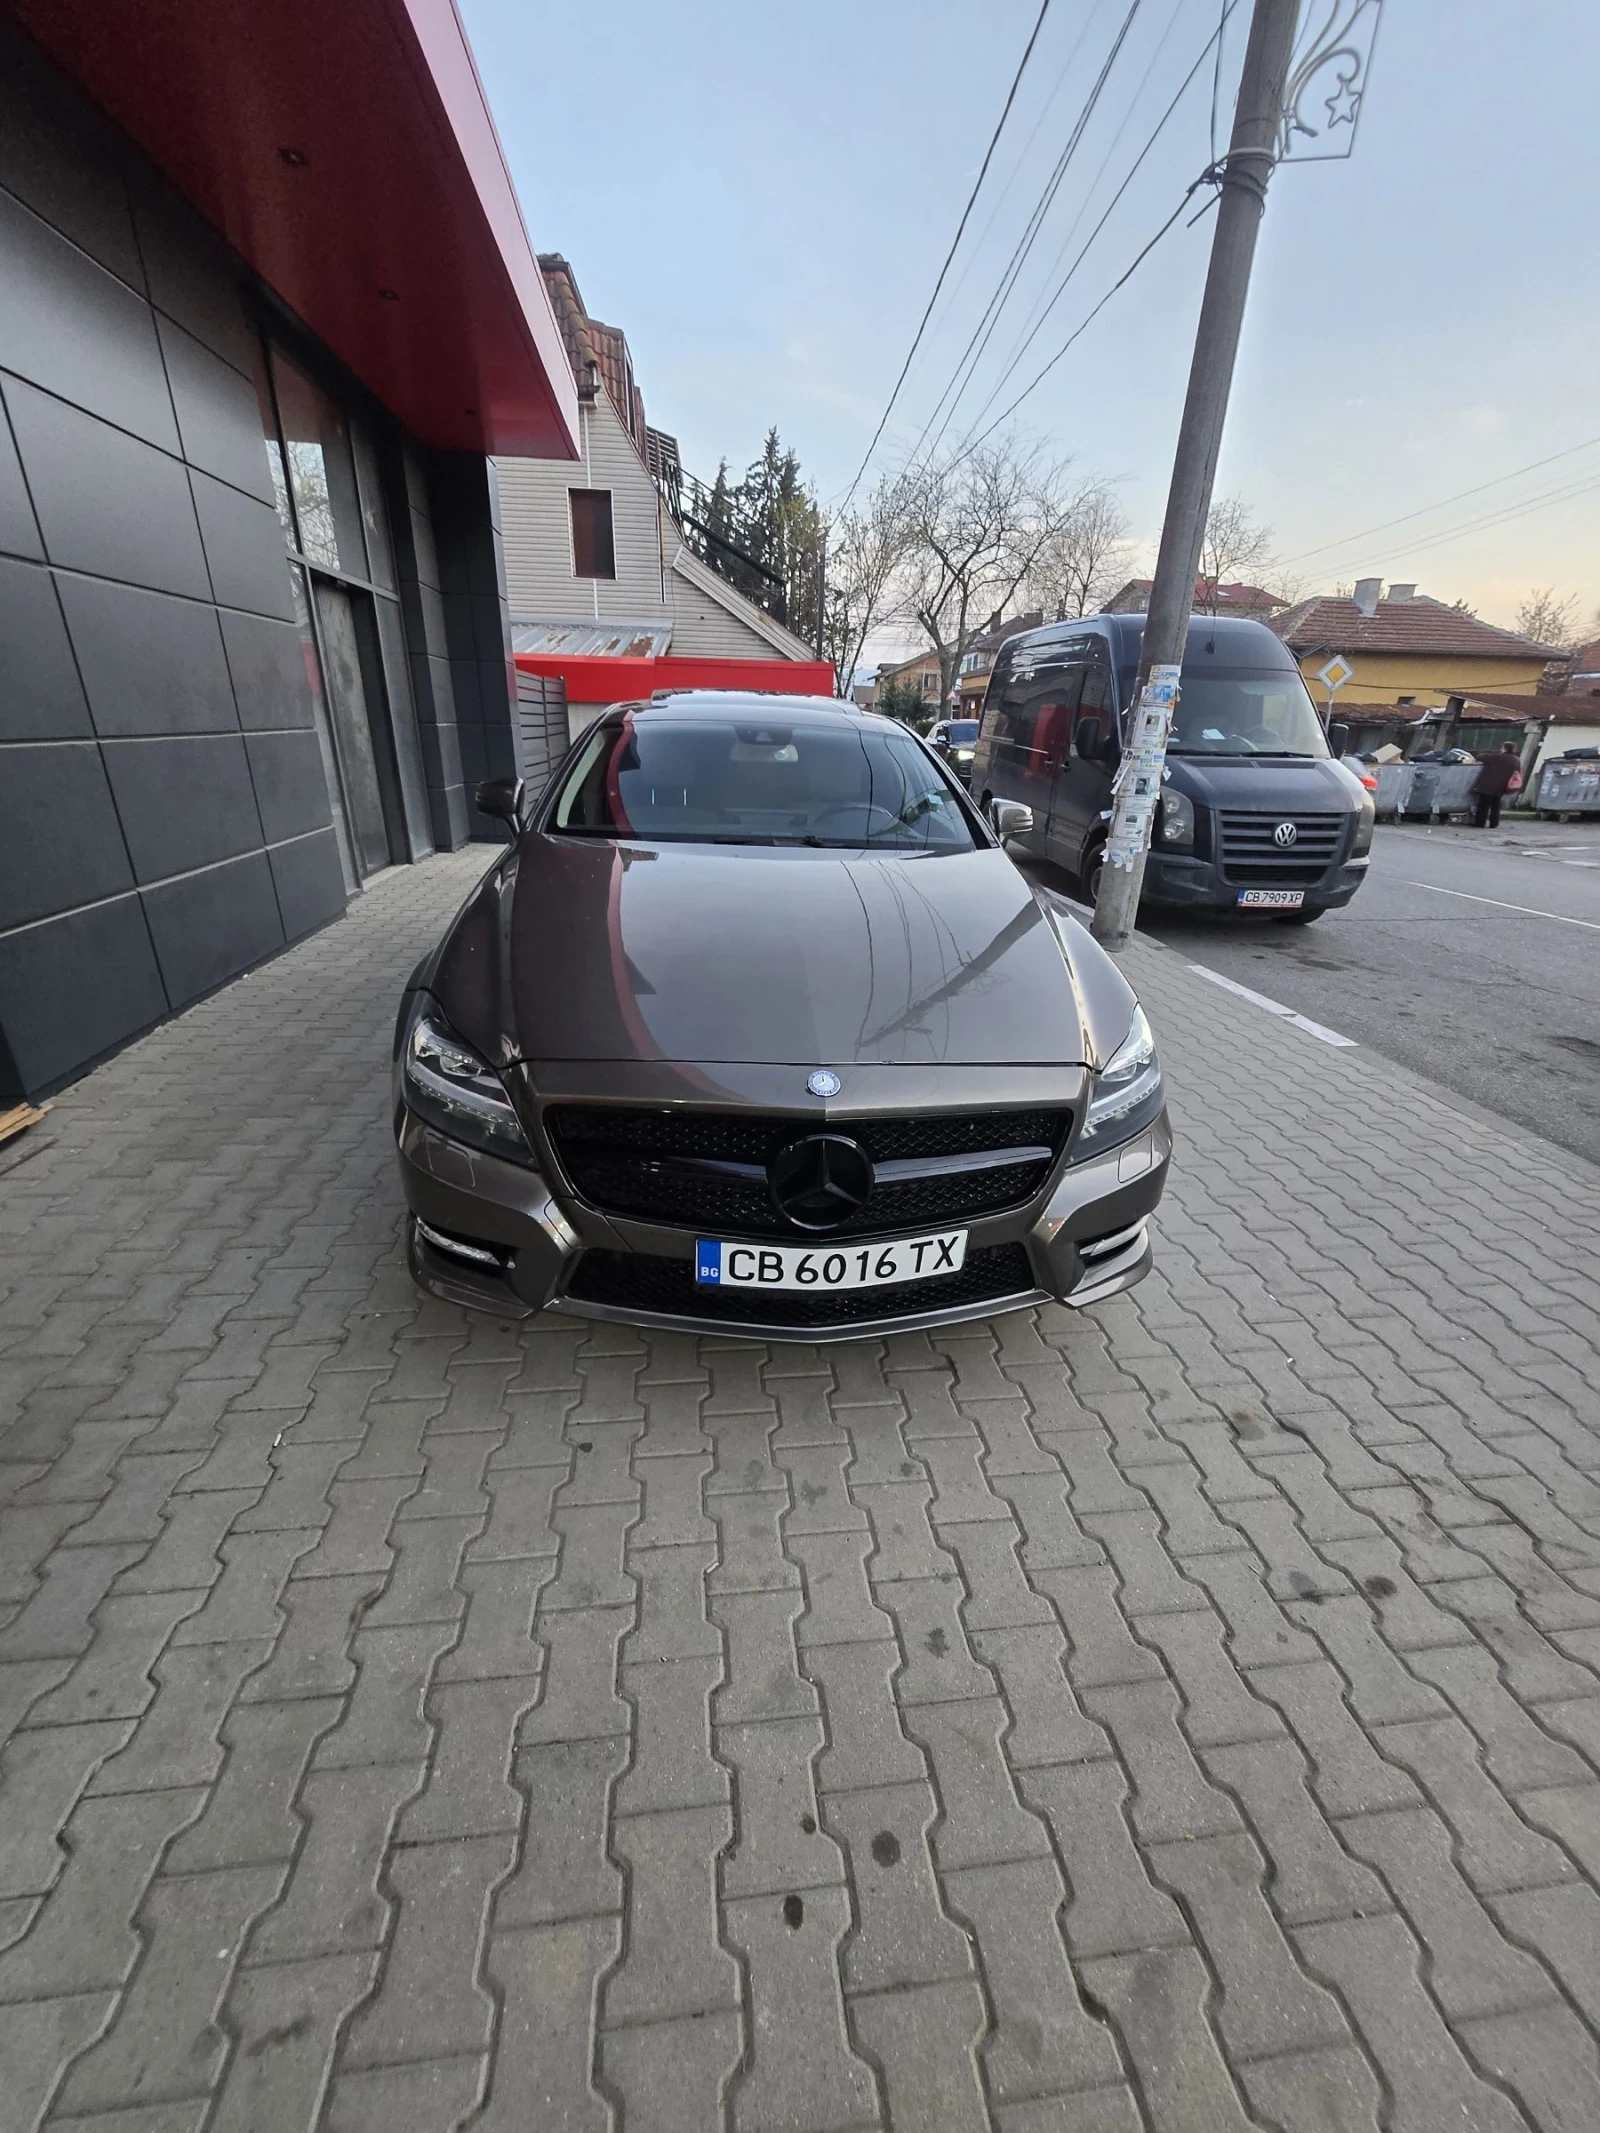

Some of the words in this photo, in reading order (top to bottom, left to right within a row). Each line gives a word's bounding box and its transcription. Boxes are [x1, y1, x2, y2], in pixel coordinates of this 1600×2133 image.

[1245, 892, 1260, 902] CB
[1261, 892, 1287, 903] 7909
[1288, 893, 1302, 903] XP
[728, 1249, 784, 1283] CB
[795, 1247, 897, 1284] 6016
[909, 1235, 959, 1274] TX
[701, 1266, 719, 1278] BG
